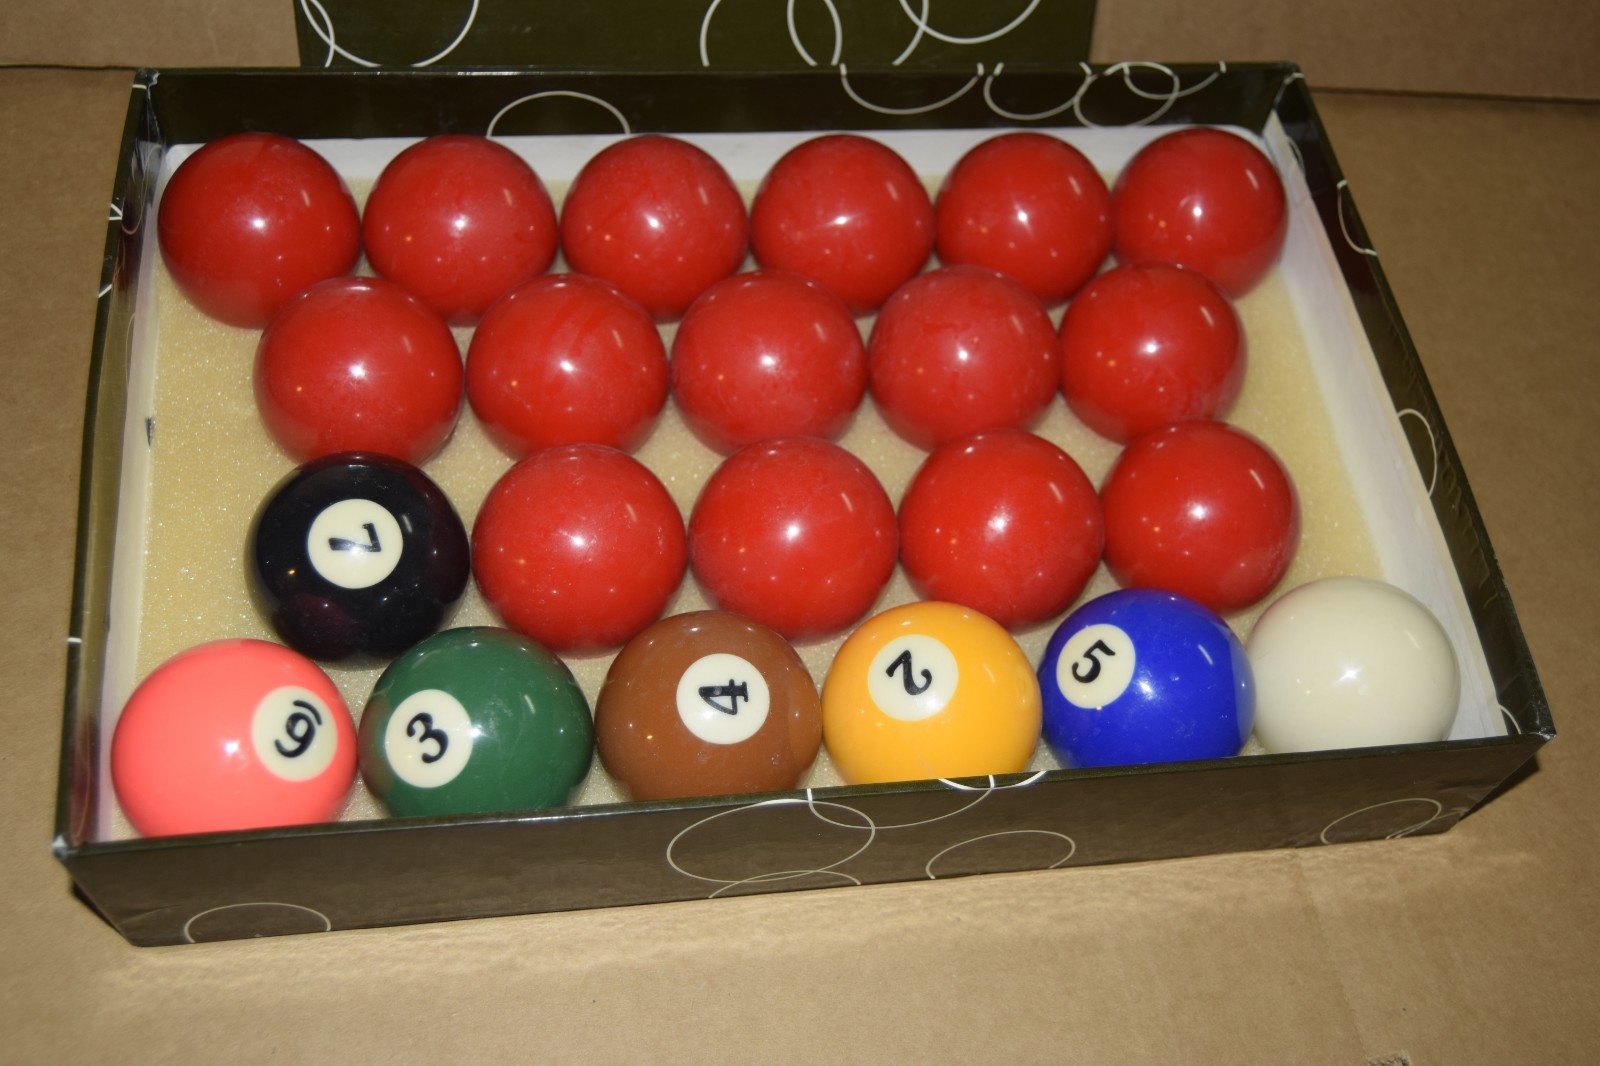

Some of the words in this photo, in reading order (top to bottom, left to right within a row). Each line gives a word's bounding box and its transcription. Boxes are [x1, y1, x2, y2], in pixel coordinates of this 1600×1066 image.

[327, 522, 382, 553] 7
[885, 649, 934, 697] 2
[1071, 639, 1117, 685] 5
[698, 678, 749, 717] 4
[275, 711, 317, 760] 6
[405, 711, 449, 764] 3
